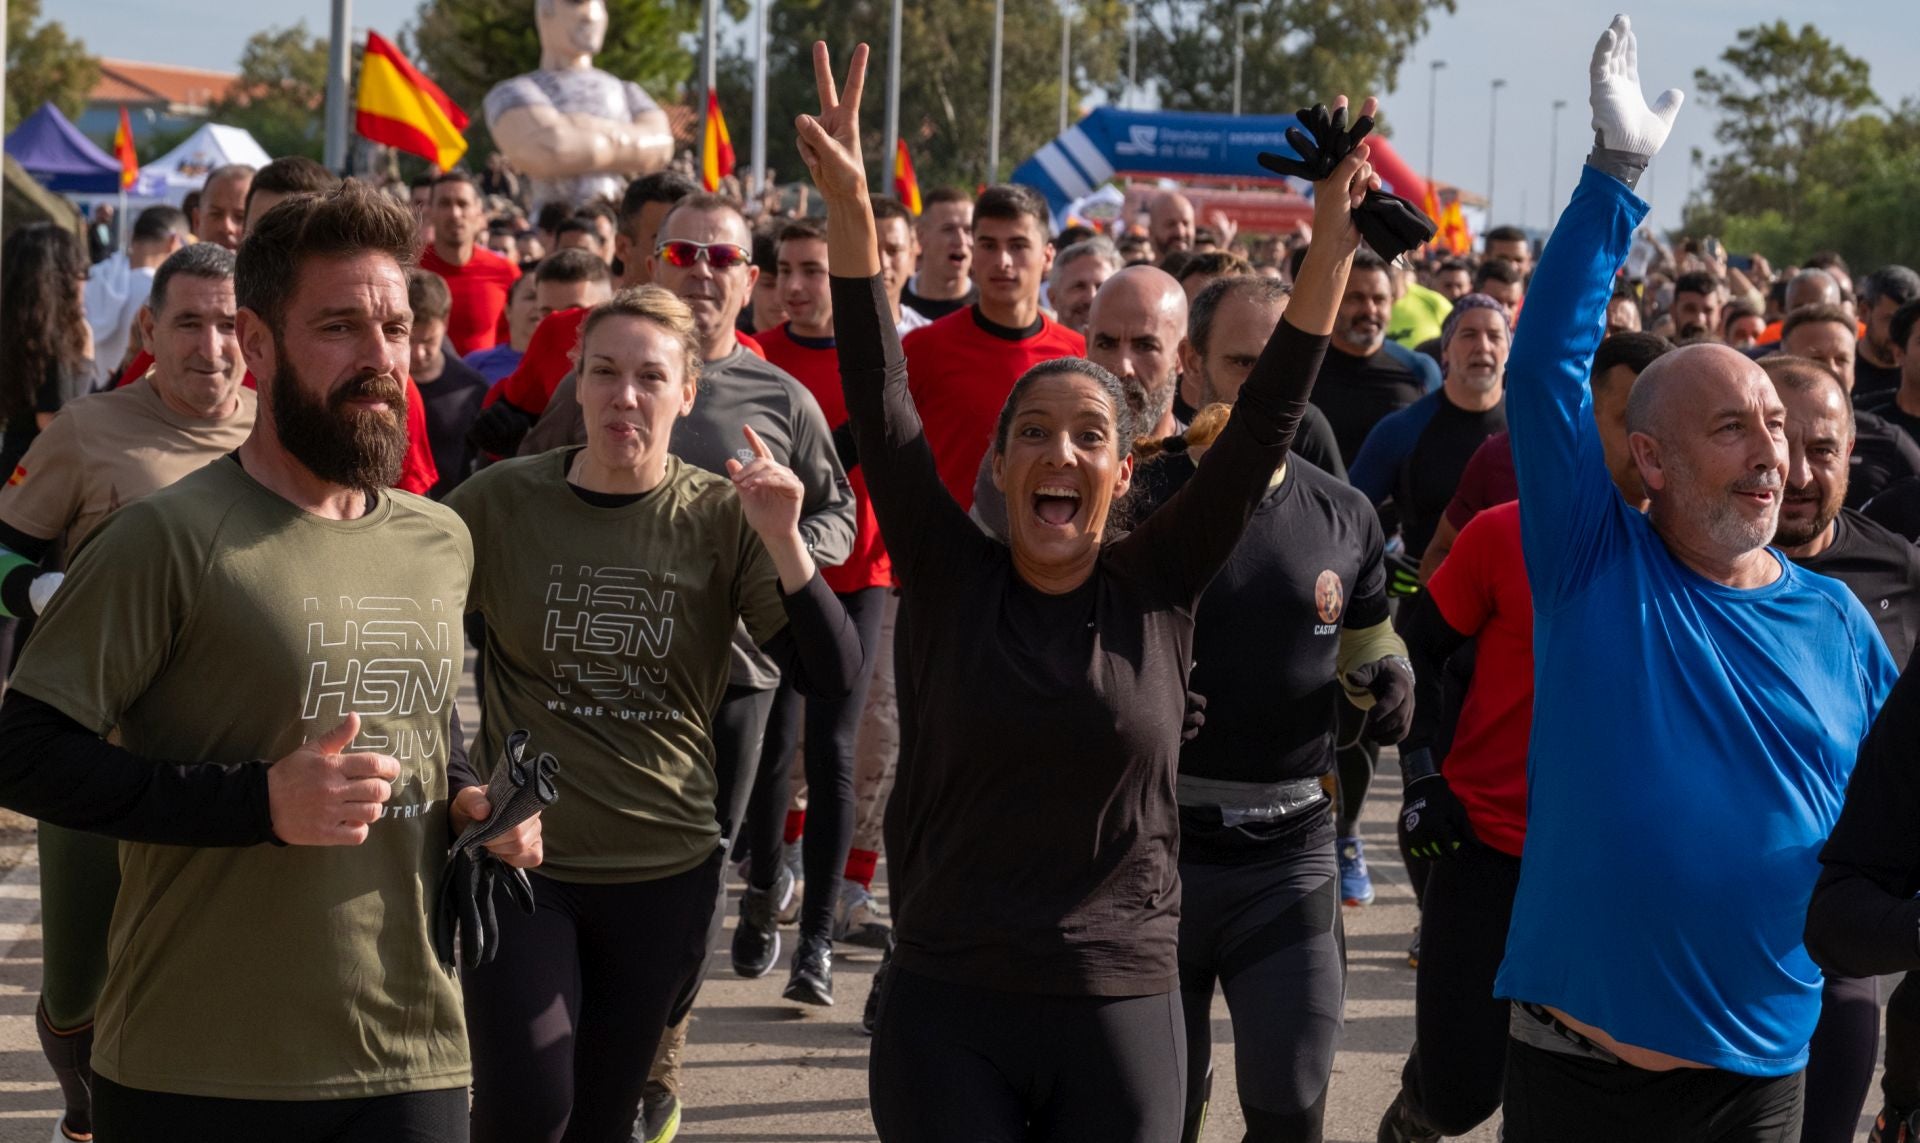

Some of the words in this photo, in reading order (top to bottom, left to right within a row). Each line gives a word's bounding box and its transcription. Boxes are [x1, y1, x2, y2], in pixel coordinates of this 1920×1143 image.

[543, 610, 674, 658] HSN
[301, 658, 451, 719] HSN
[547, 700, 566, 711] WE
[573, 706, 604, 717] ARE
[611, 709, 684, 721] NUTRITIO
